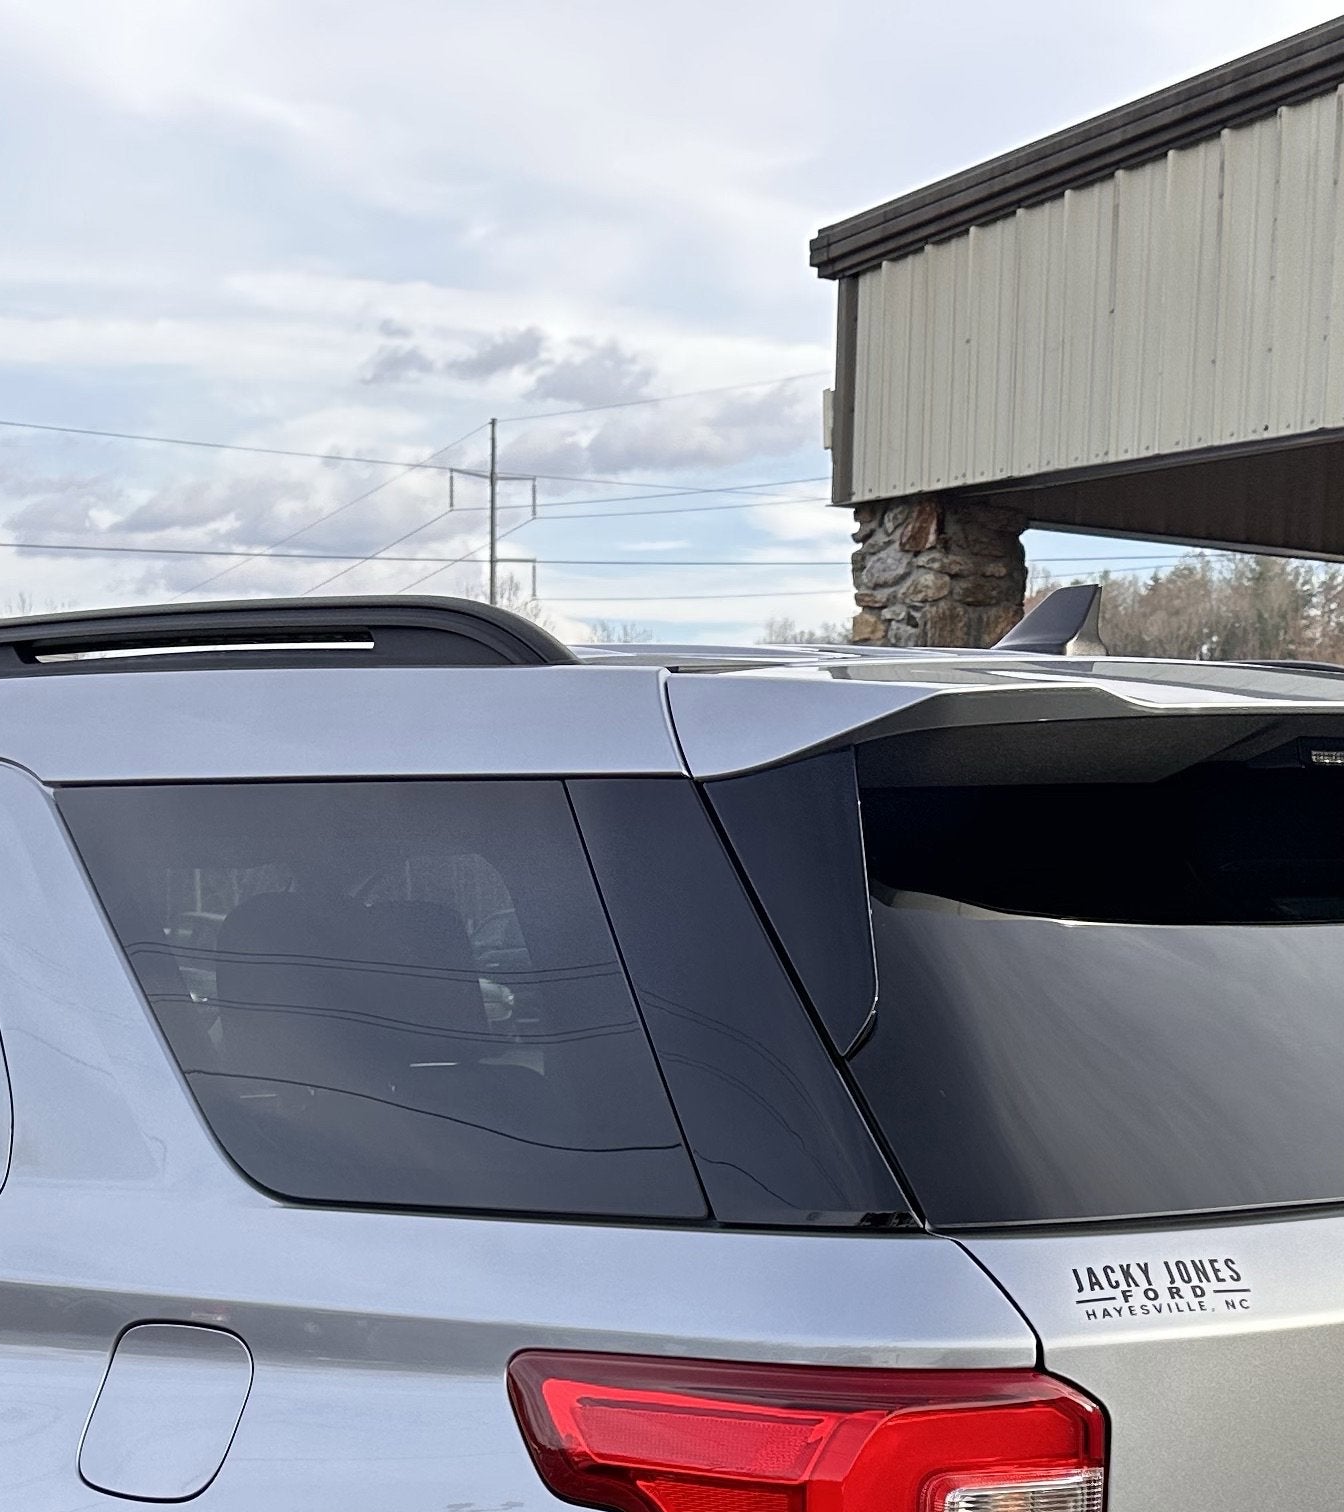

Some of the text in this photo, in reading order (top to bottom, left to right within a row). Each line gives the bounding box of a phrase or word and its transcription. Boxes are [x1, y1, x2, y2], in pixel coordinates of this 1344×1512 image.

[1072, 1258, 1242, 1293] JACKY JONES
[1121, 1285, 1206, 1303] FORD
[1224, 1298, 1251, 1310] NC
